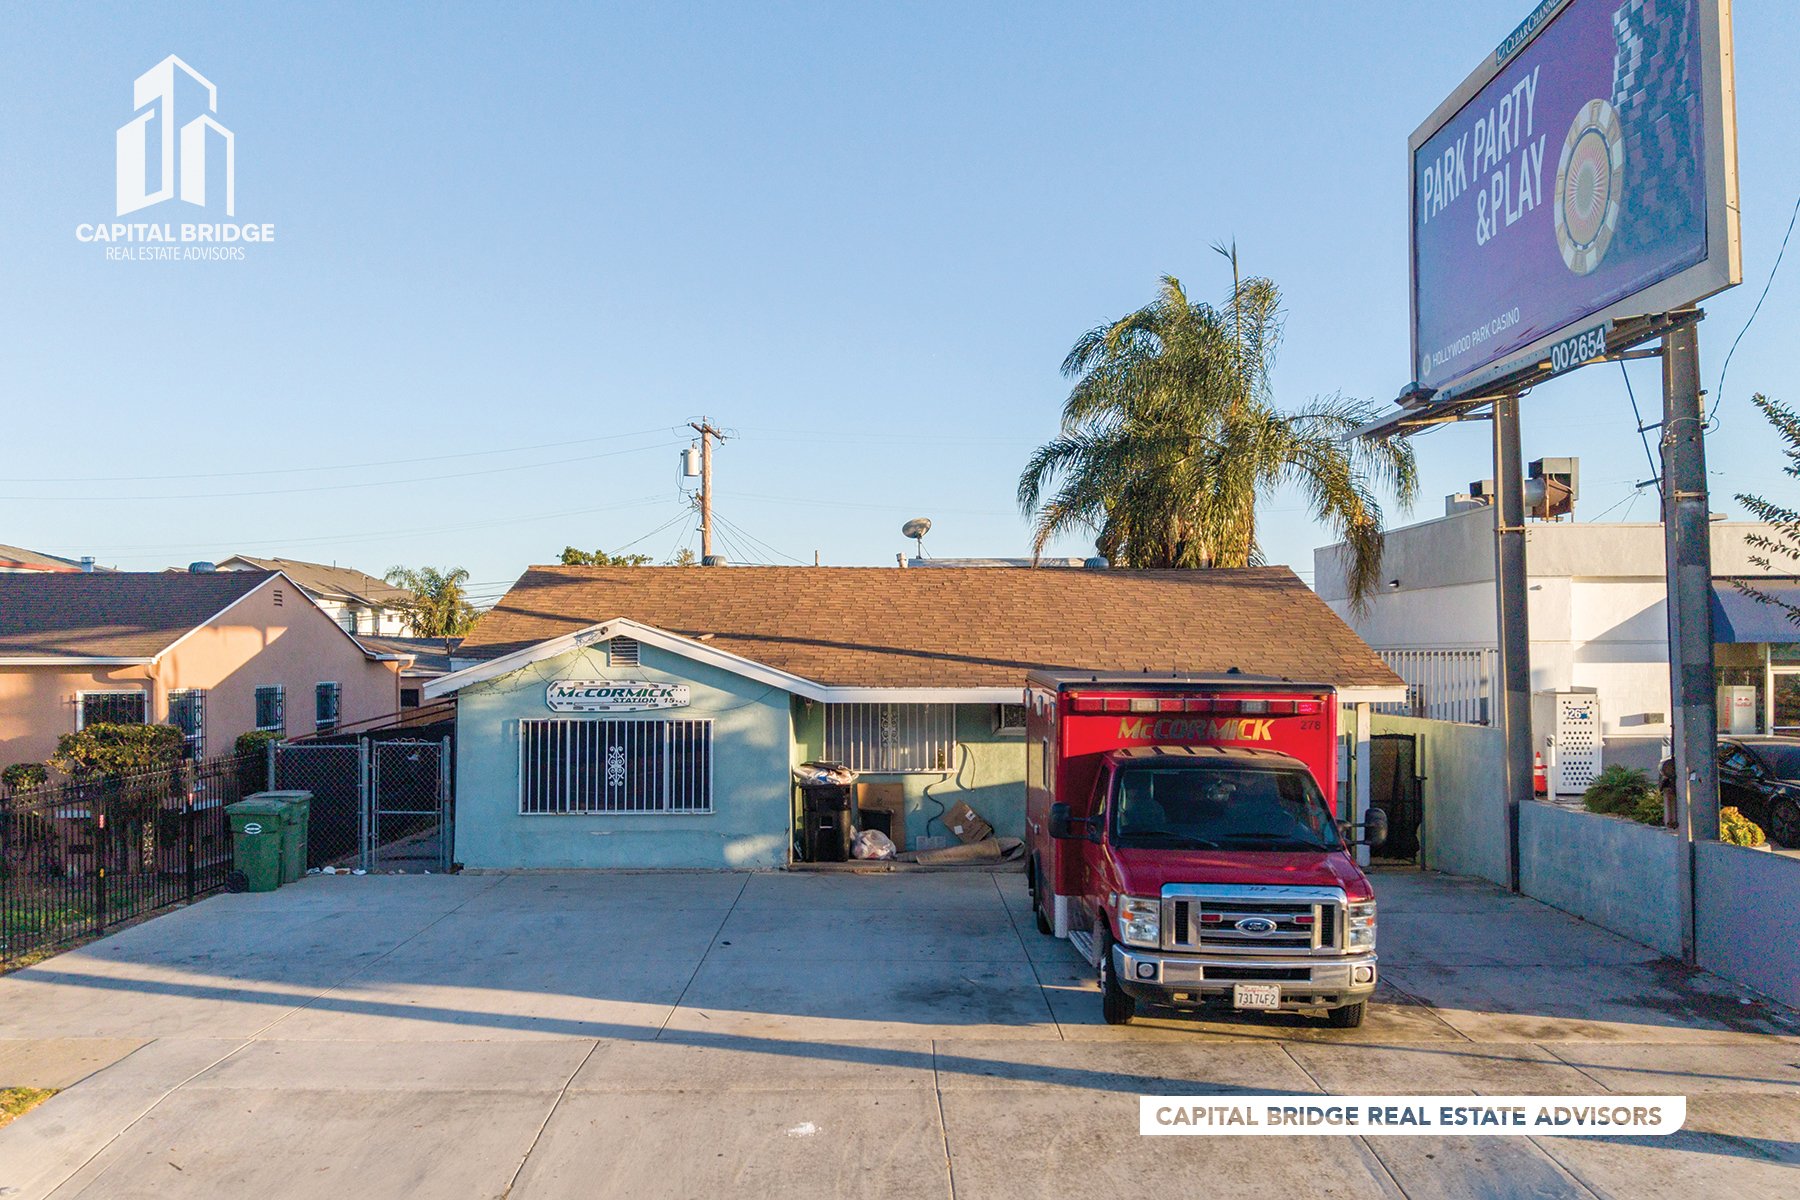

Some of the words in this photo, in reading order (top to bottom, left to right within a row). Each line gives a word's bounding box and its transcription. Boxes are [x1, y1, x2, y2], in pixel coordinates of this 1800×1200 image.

[1424, 131, 1468, 224] PARK
[1473, 64, 1540, 183] PARTY
[1432, 335, 1471, 367] HOLLYWOOD
[1472, 322, 1491, 347] PARK
[1491, 306, 1520, 335] CASINO
[1552, 327, 1606, 371] 002654
[1300, 720, 1321, 731] 278
